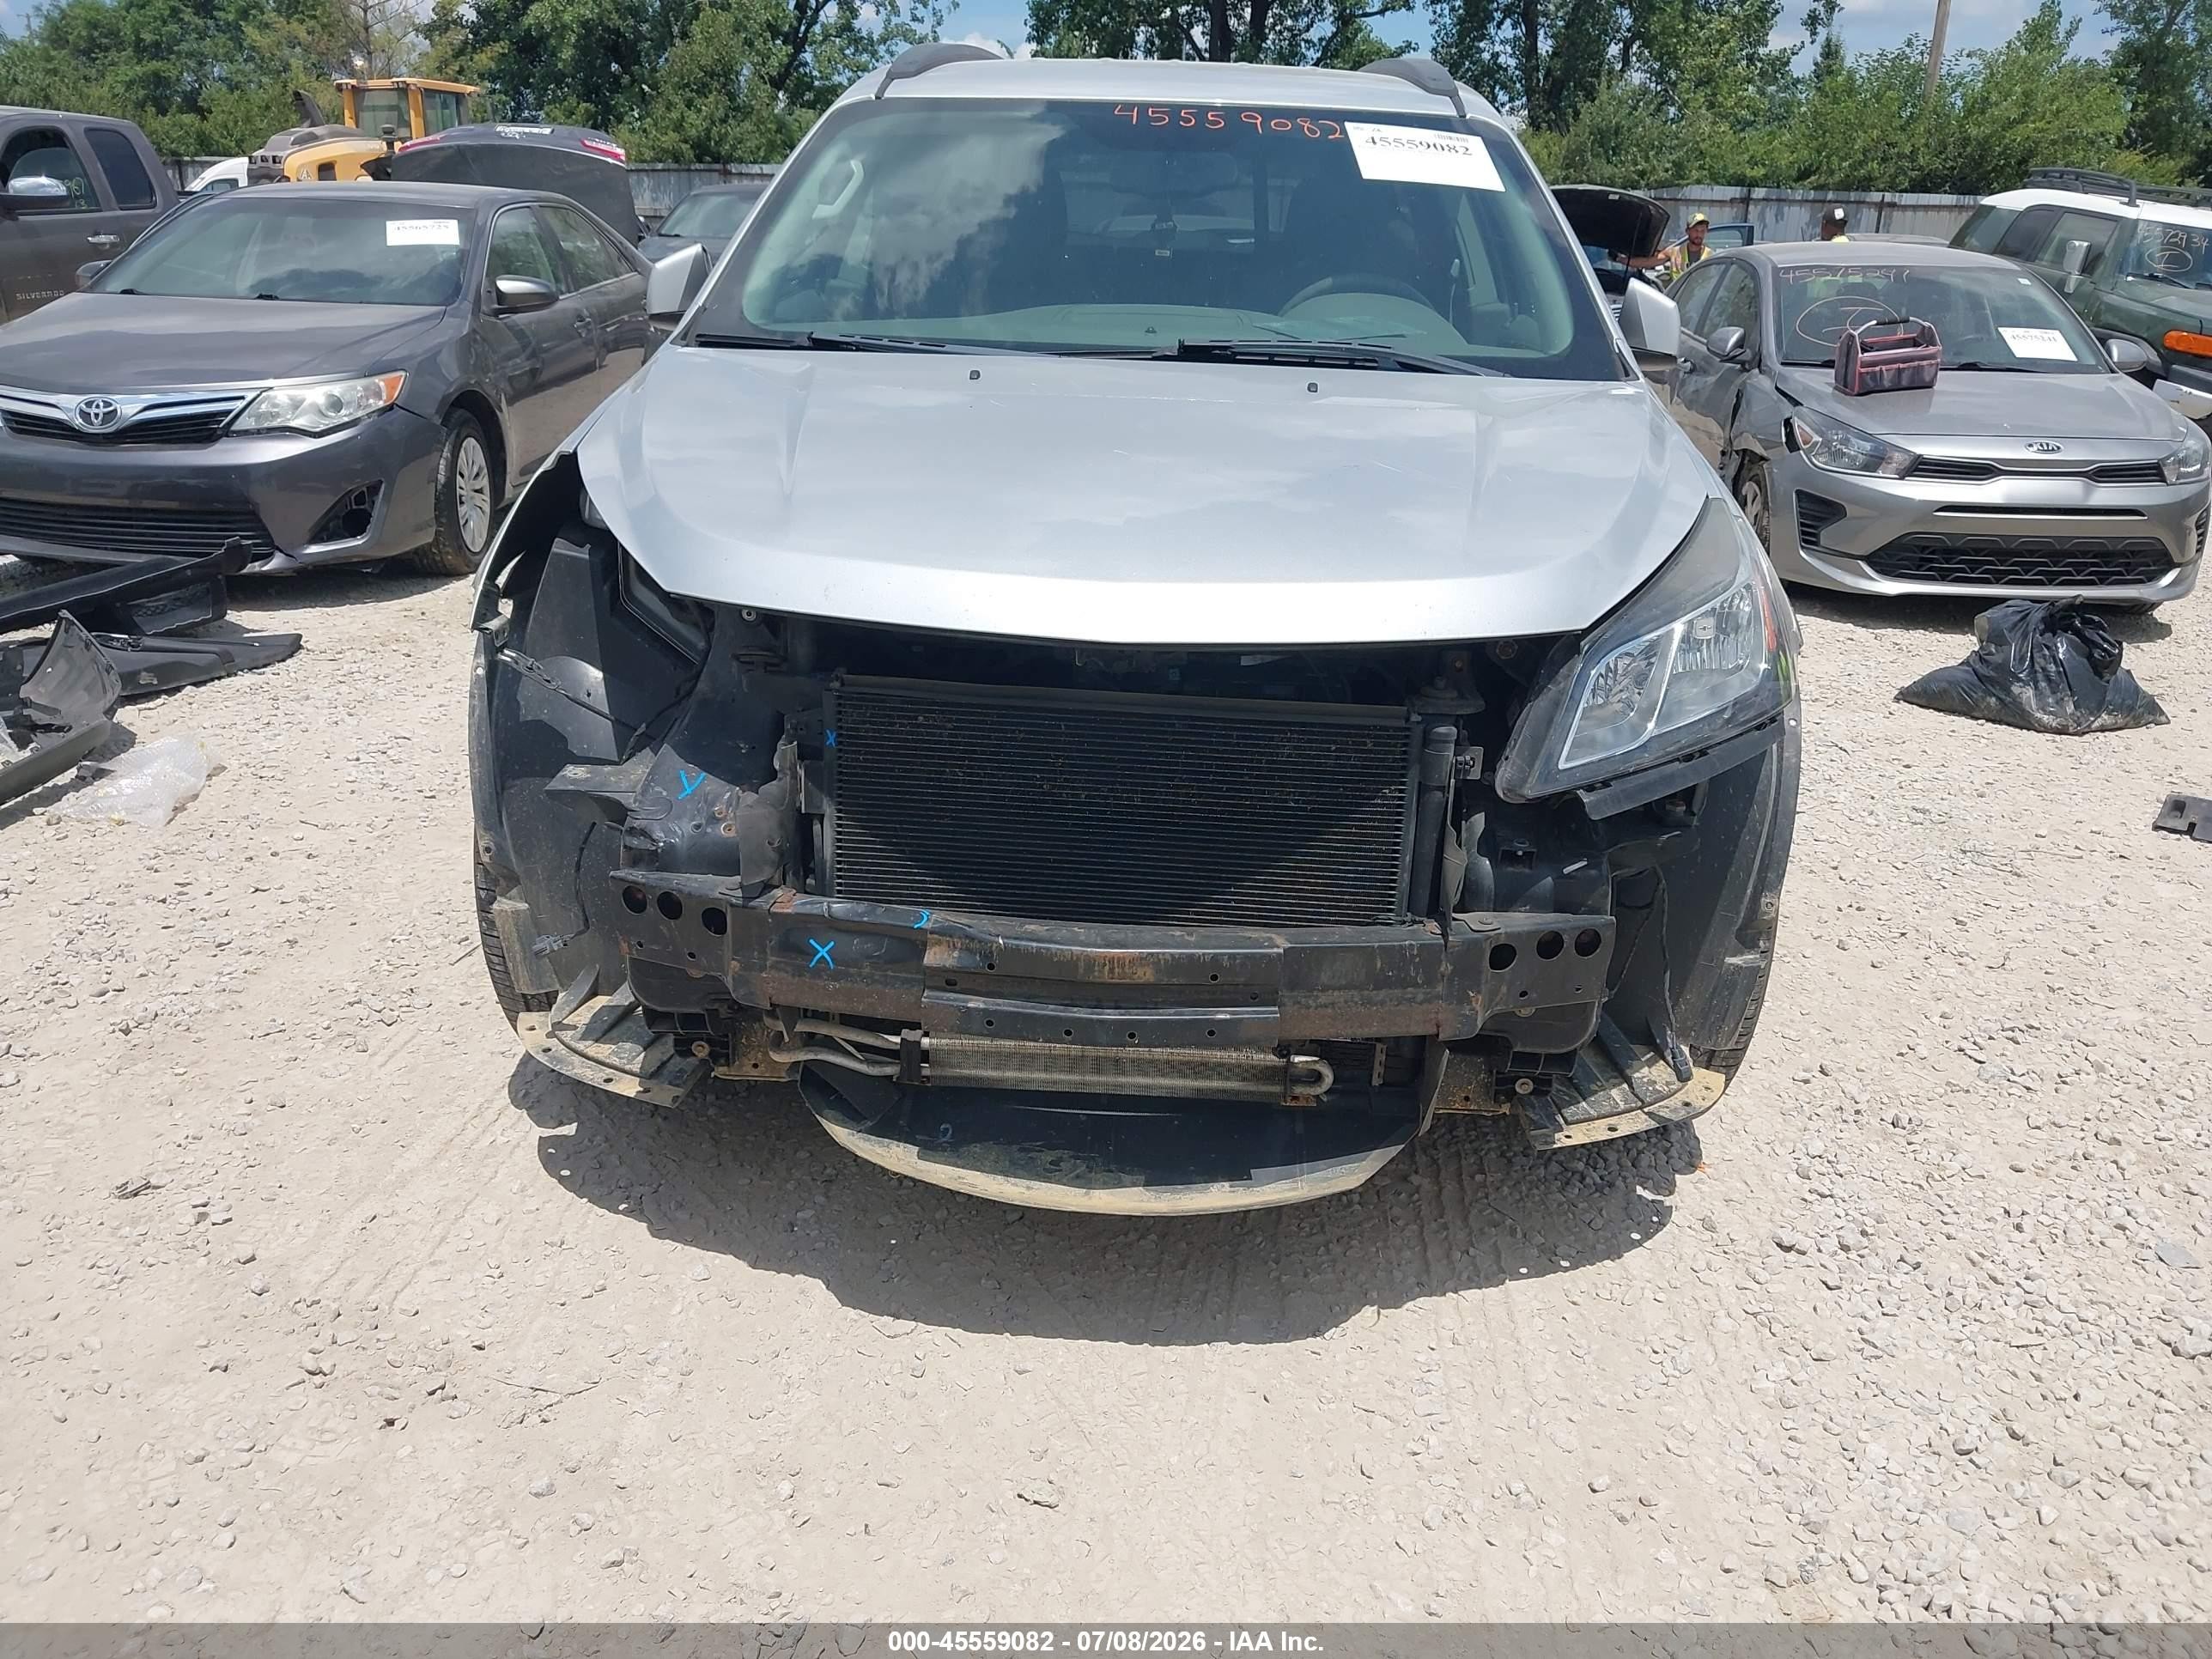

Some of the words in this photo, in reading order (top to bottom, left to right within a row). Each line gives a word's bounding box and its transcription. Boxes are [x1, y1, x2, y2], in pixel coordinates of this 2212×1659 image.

[1114, 104, 1345, 138] 45559082
[1365, 136, 1473, 155] 45559082
[15, 289, 65, 300] SILVERADO
[2027, 441, 2061, 452] KIA
